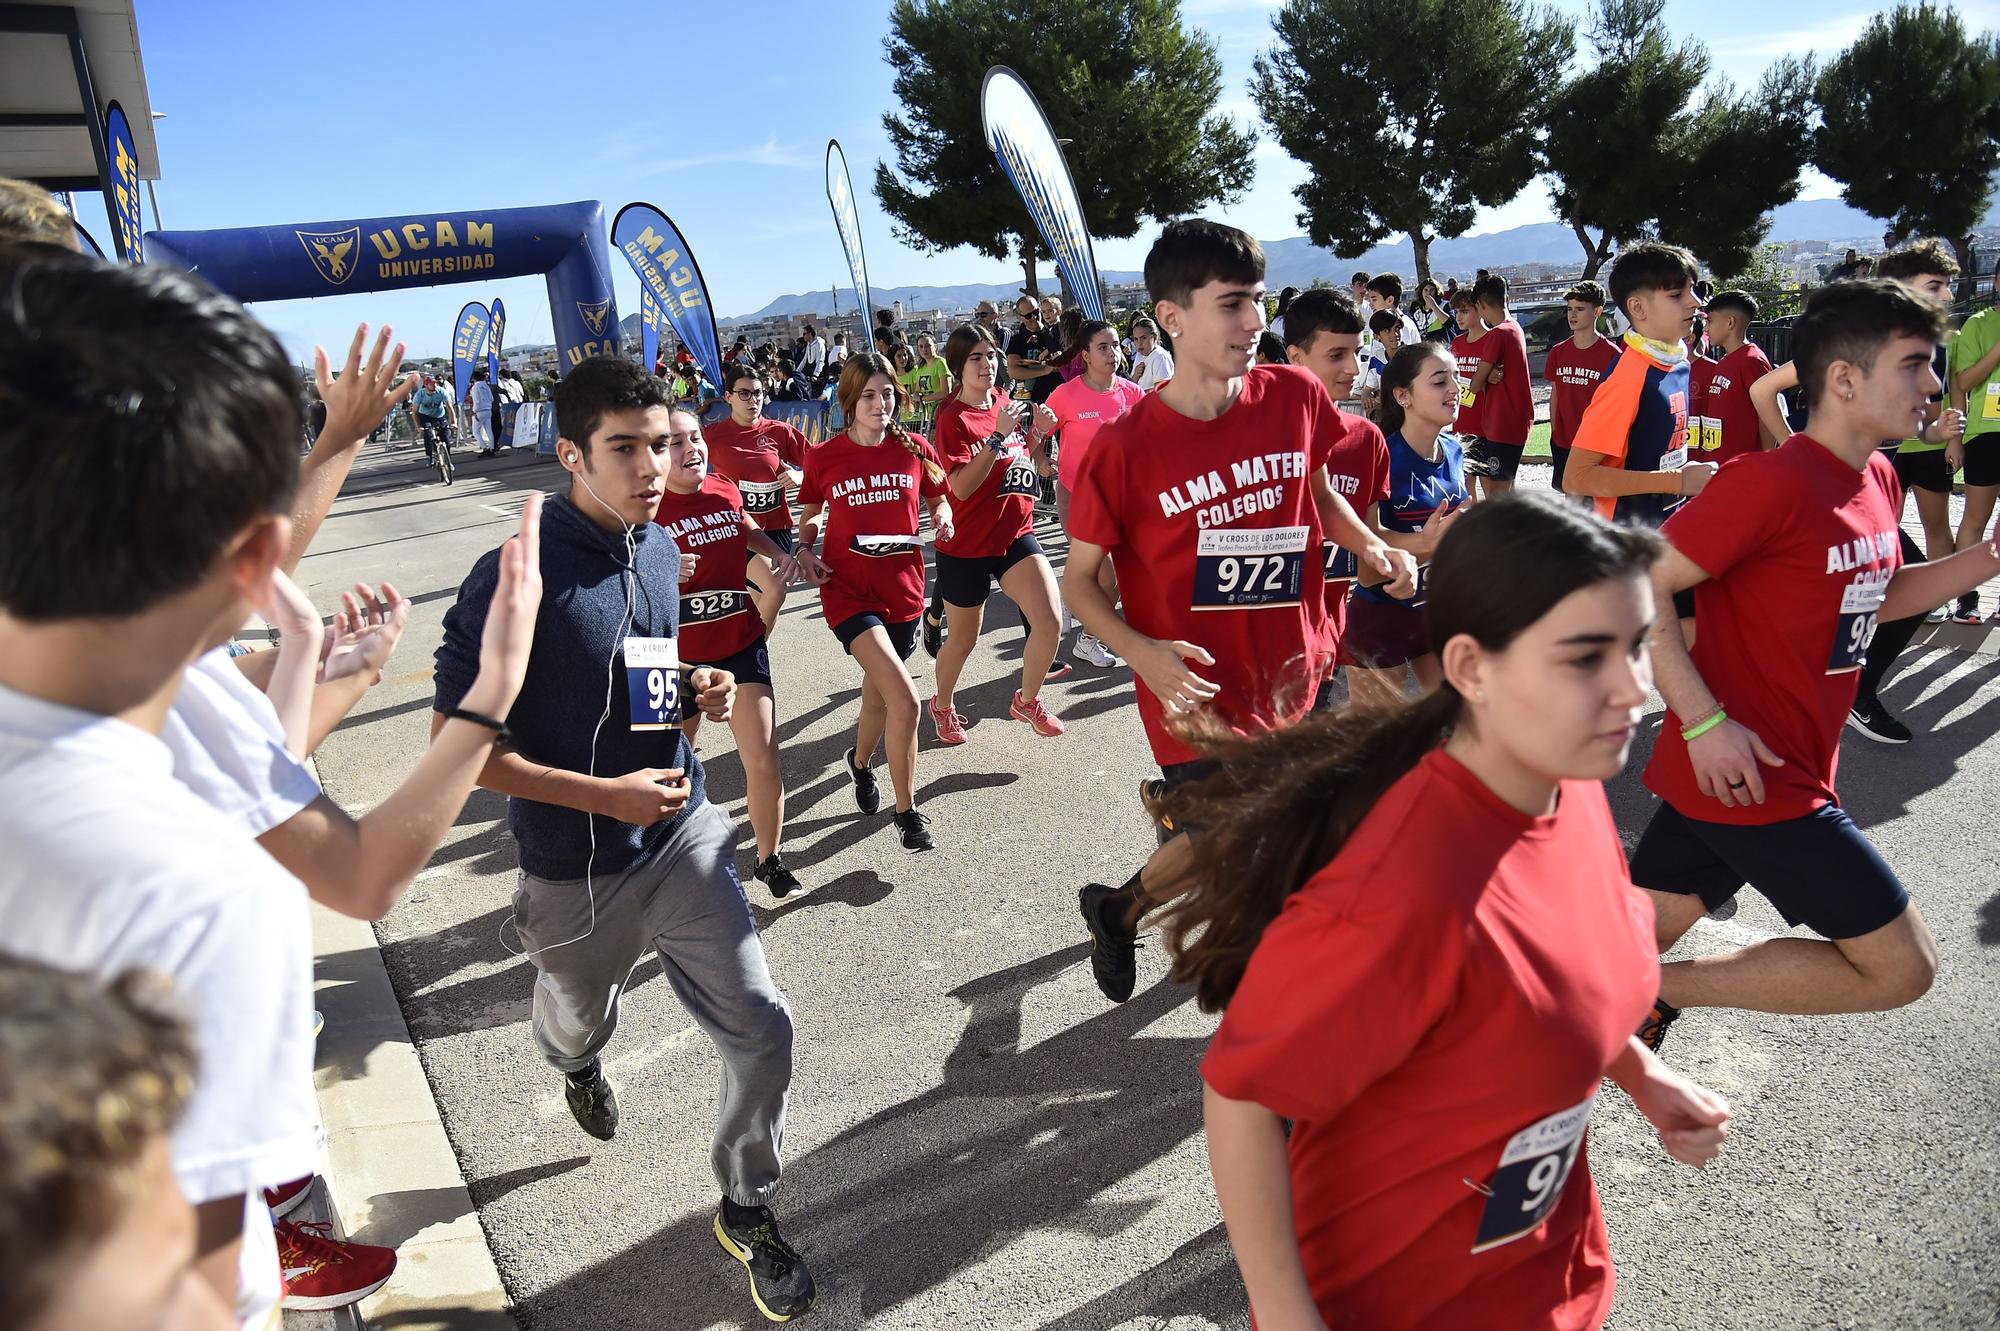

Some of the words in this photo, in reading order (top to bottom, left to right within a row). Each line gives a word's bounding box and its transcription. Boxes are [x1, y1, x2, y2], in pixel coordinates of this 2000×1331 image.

[116, 135, 132, 265] CAM
[316, 235, 346, 244] UCAM
[370, 220, 493, 259] UCAM
[379, 253, 495, 278] UNIVERSIDAD
[456, 313, 479, 359] UCAM
[1575, 367, 1601, 380] MATER
[1078, 411, 1100, 420] MADISON
[832, 477, 866, 499] ALMA
[870, 473, 914, 489] MATER
[1005, 468, 1034, 488] 930
[1158, 471, 1227, 518] ALMA
[1231, 452, 1306, 489] MATER
[1327, 473, 1360, 495] ATER
[746, 492, 776, 507] 934
[847, 489, 900, 507] COLEGIOS
[1196, 485, 1283, 529] COLEGIOS
[664, 517, 703, 539] ALMA
[687, 524, 739, 547] COLEGIOS
[1219, 535, 1224, 543] V
[1226, 534, 1249, 543] CROSS
[1251, 534, 1259, 542] DE
[1262, 533, 1274, 542] LOS
[1275, 531, 1305, 541] DOLORES
[1234, 543, 1261, 551] Presidente
[1217, 555, 1285, 592] 972
[690, 592, 734, 615] 928
